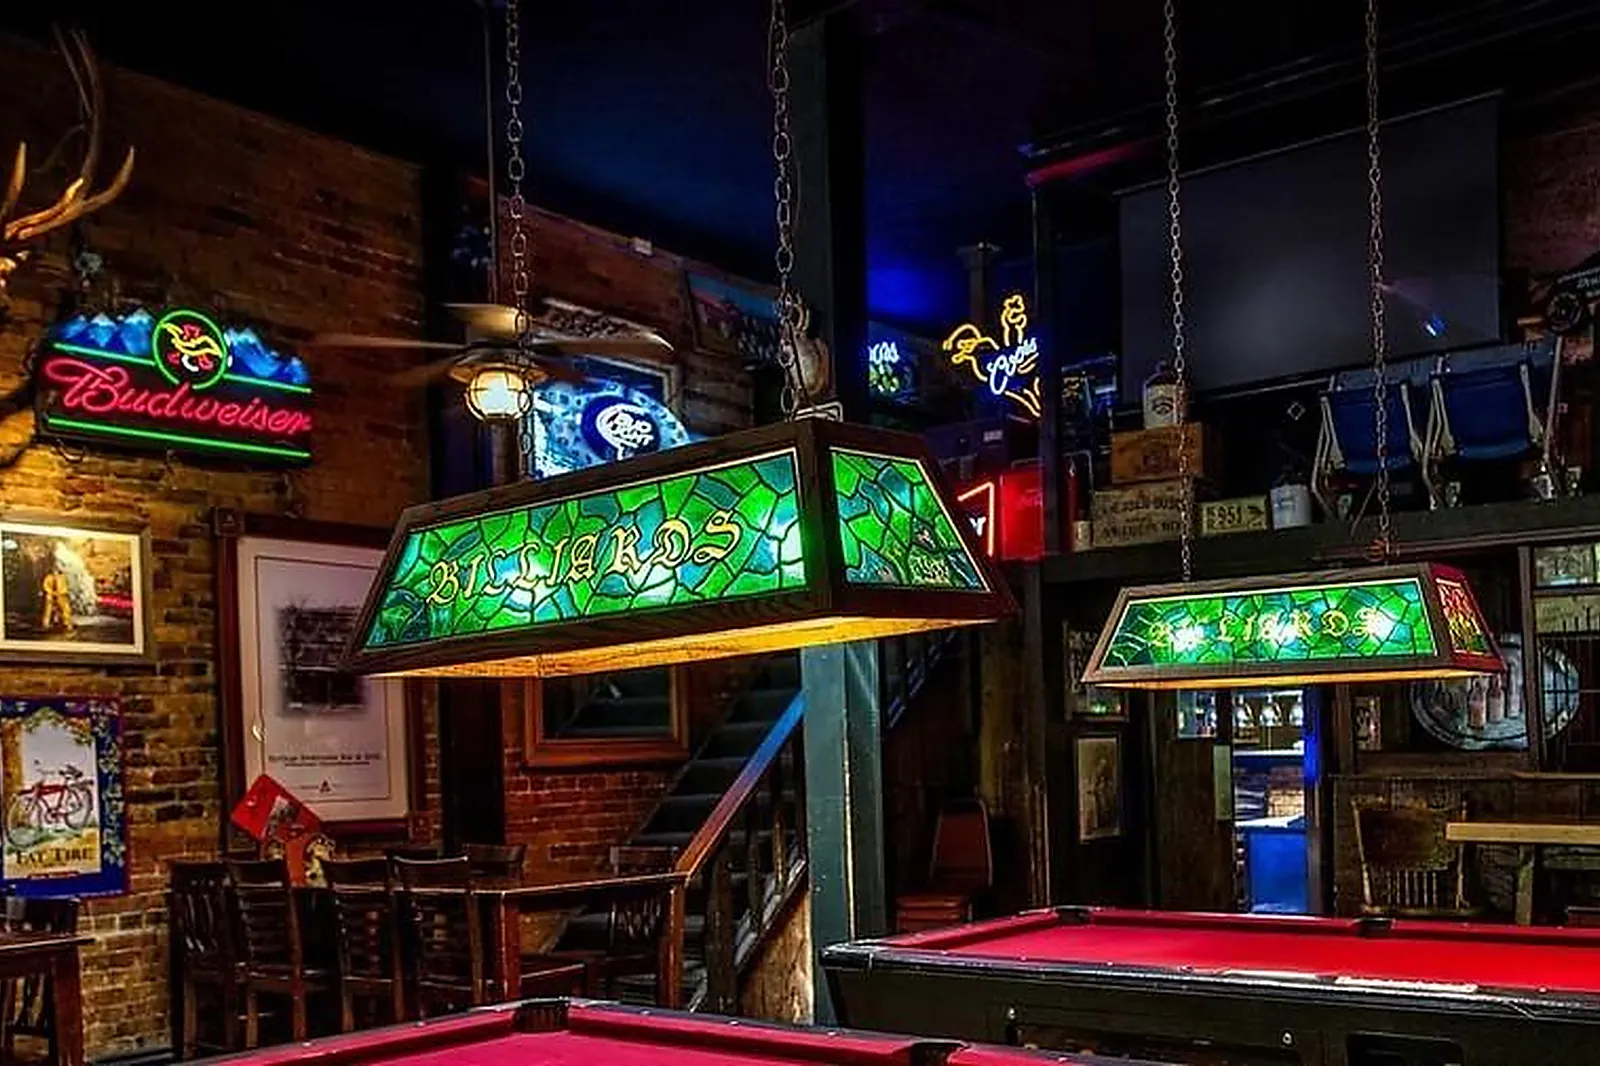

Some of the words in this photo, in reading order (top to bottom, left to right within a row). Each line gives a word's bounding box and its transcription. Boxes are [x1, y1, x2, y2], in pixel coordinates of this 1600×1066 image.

[45, 359, 312, 434] Budweiser
[427, 509, 742, 604] BILLIARDS
[1150, 606, 1390, 647] BLIARDS
